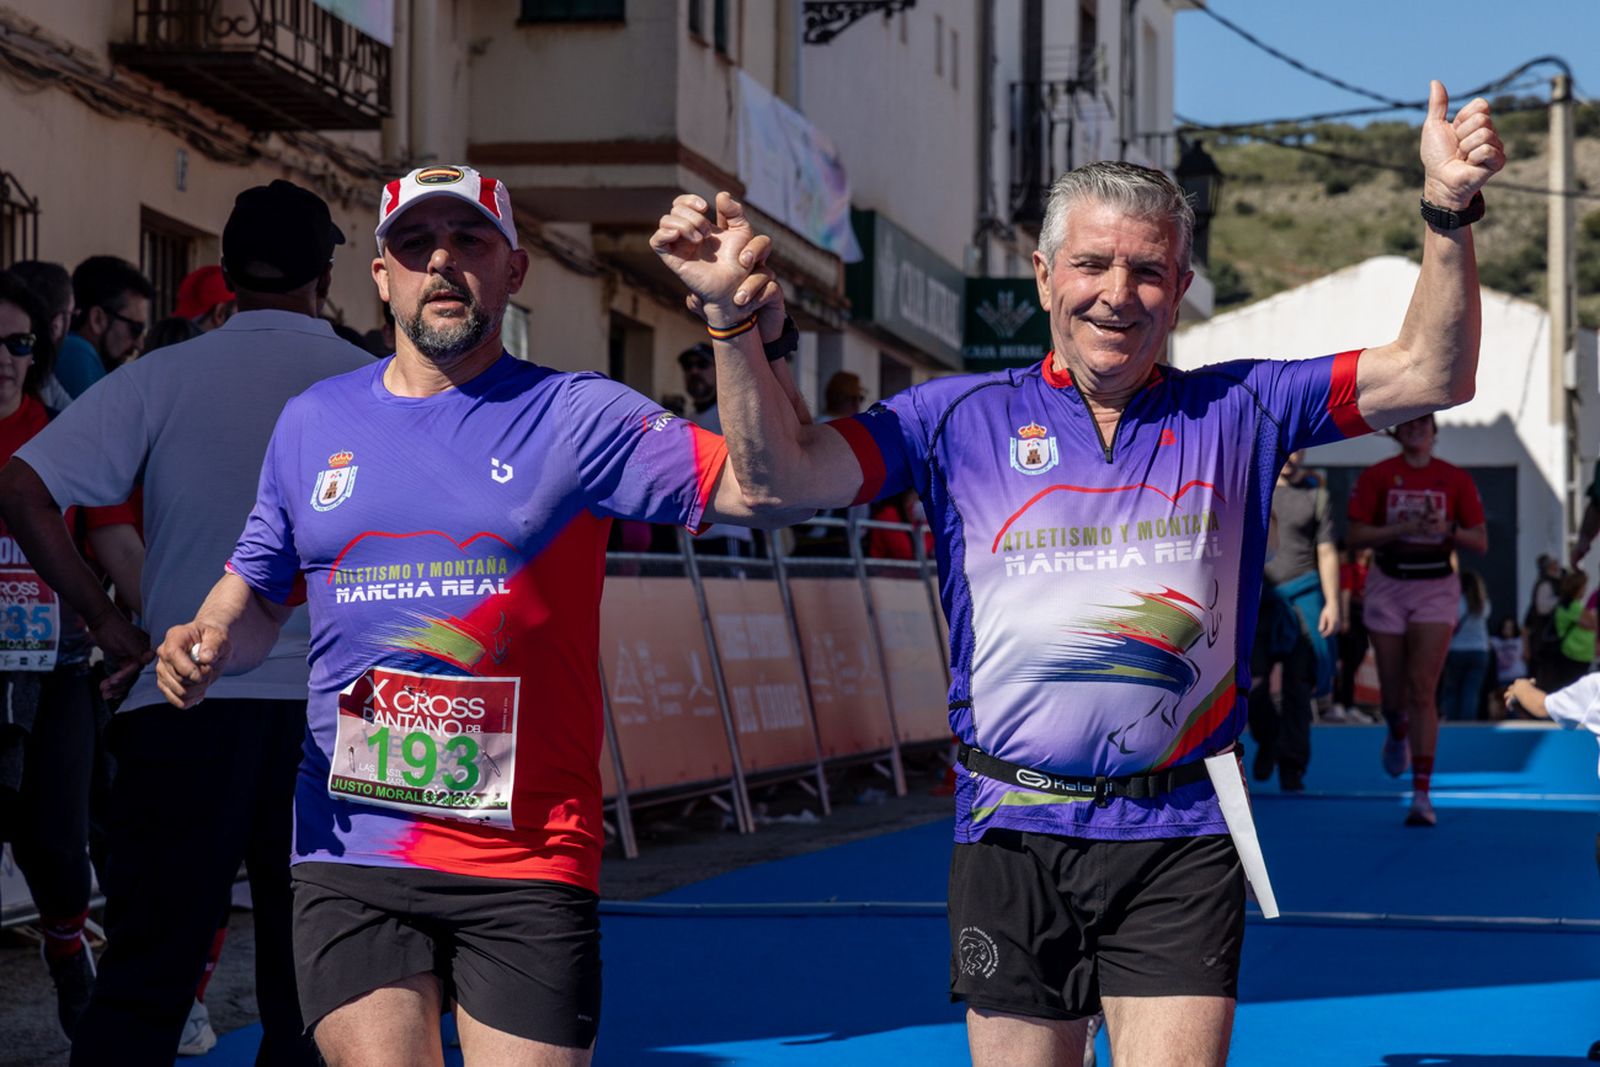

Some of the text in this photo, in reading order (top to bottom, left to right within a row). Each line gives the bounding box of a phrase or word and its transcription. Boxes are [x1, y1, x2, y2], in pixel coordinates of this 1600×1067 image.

[1003, 526, 1112, 551] ATLETISMO
[1120, 525, 1130, 543] Y
[335, 555, 508, 584] ATLETISMO Y MONTAÑA
[1004, 538, 1222, 577] MANCHA REAL
[336, 578, 511, 604] MANCHA REAL
[0, 606, 52, 641] 35
[364, 675, 390, 709] X
[393, 690, 486, 719] CROSS
[362, 707, 462, 738] PANTANO
[367, 727, 480, 791] 193
[331, 778, 373, 795] JUSTO
